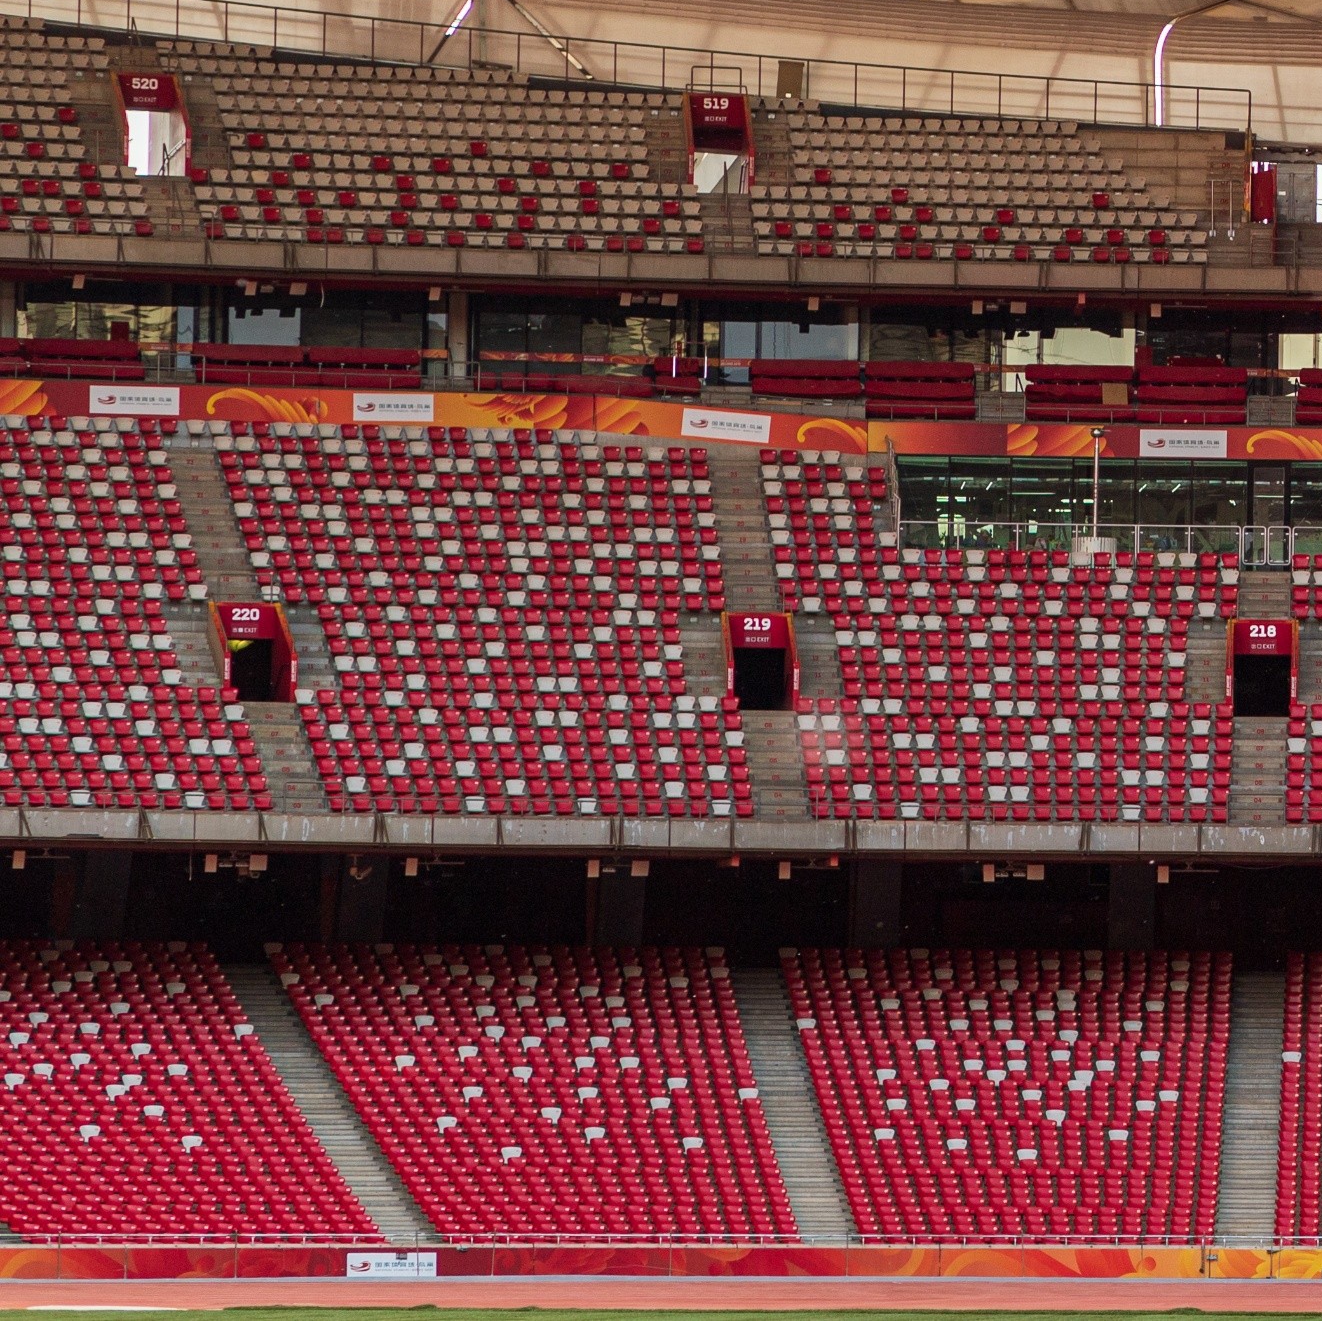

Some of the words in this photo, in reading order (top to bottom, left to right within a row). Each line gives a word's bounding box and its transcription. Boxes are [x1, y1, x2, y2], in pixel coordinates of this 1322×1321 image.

[131, 77, 158, 90] 520
[703, 97, 729, 110] 519
[232, 608, 260, 621] 220
[743, 617, 771, 631] 219
[1249, 624, 1277, 638] 218
